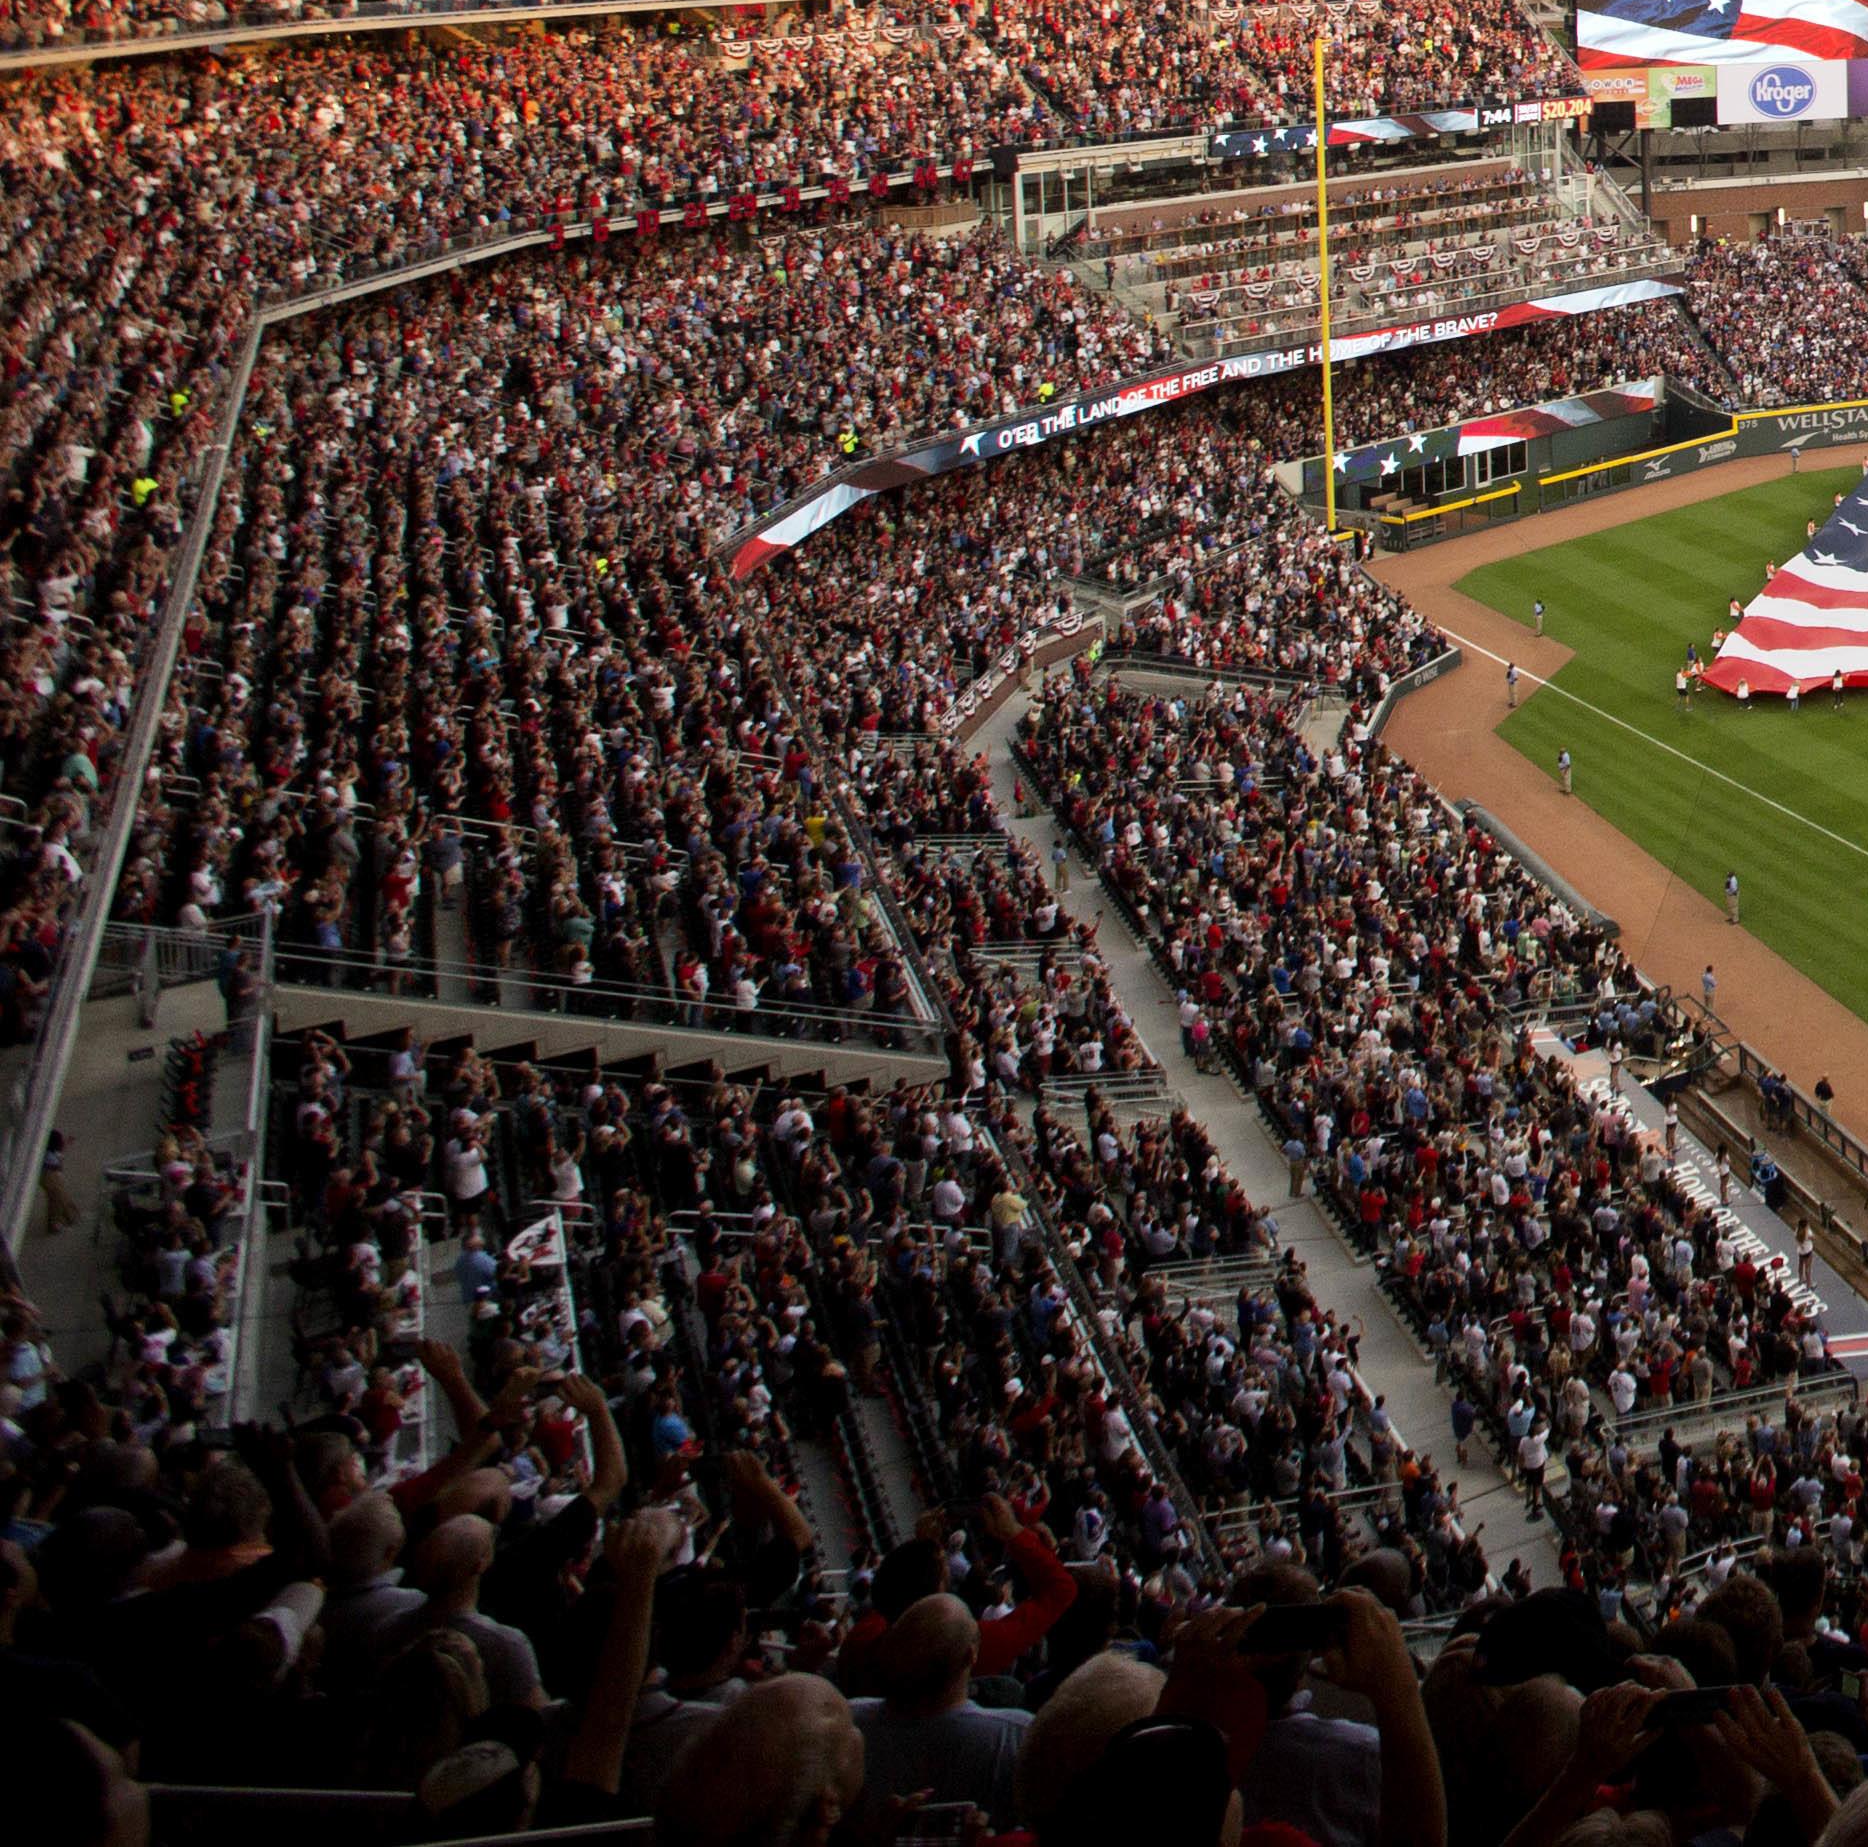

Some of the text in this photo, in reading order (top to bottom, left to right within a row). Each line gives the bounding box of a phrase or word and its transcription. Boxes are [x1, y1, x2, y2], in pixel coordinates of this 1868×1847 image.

[1756, 73, 1812, 113] Kroger
[1482, 108, 1512, 125] 7:44
[1542, 98, 1593, 120] $20,204
[684, 203, 708, 228] 21
[730, 194, 757, 220] 29
[637, 209, 660, 235] 10
[1042, 404, 1076, 433] THE
[1078, 394, 1123, 425] LAND
[1126, 389, 1147, 407] OF
[1151, 379, 1180, 401] THE
[1183, 366, 1218, 389] FREE
[1221, 358, 1262, 381] AND
[1267, 348, 1305, 370] THE
[1370, 332, 1394, 351] OF
[1396, 325, 1432, 344] THE
[1434, 312, 1499, 337] BRAVE?
[1739, 419, 1758, 431] 375
[1832, 429, 1858, 442] Health
